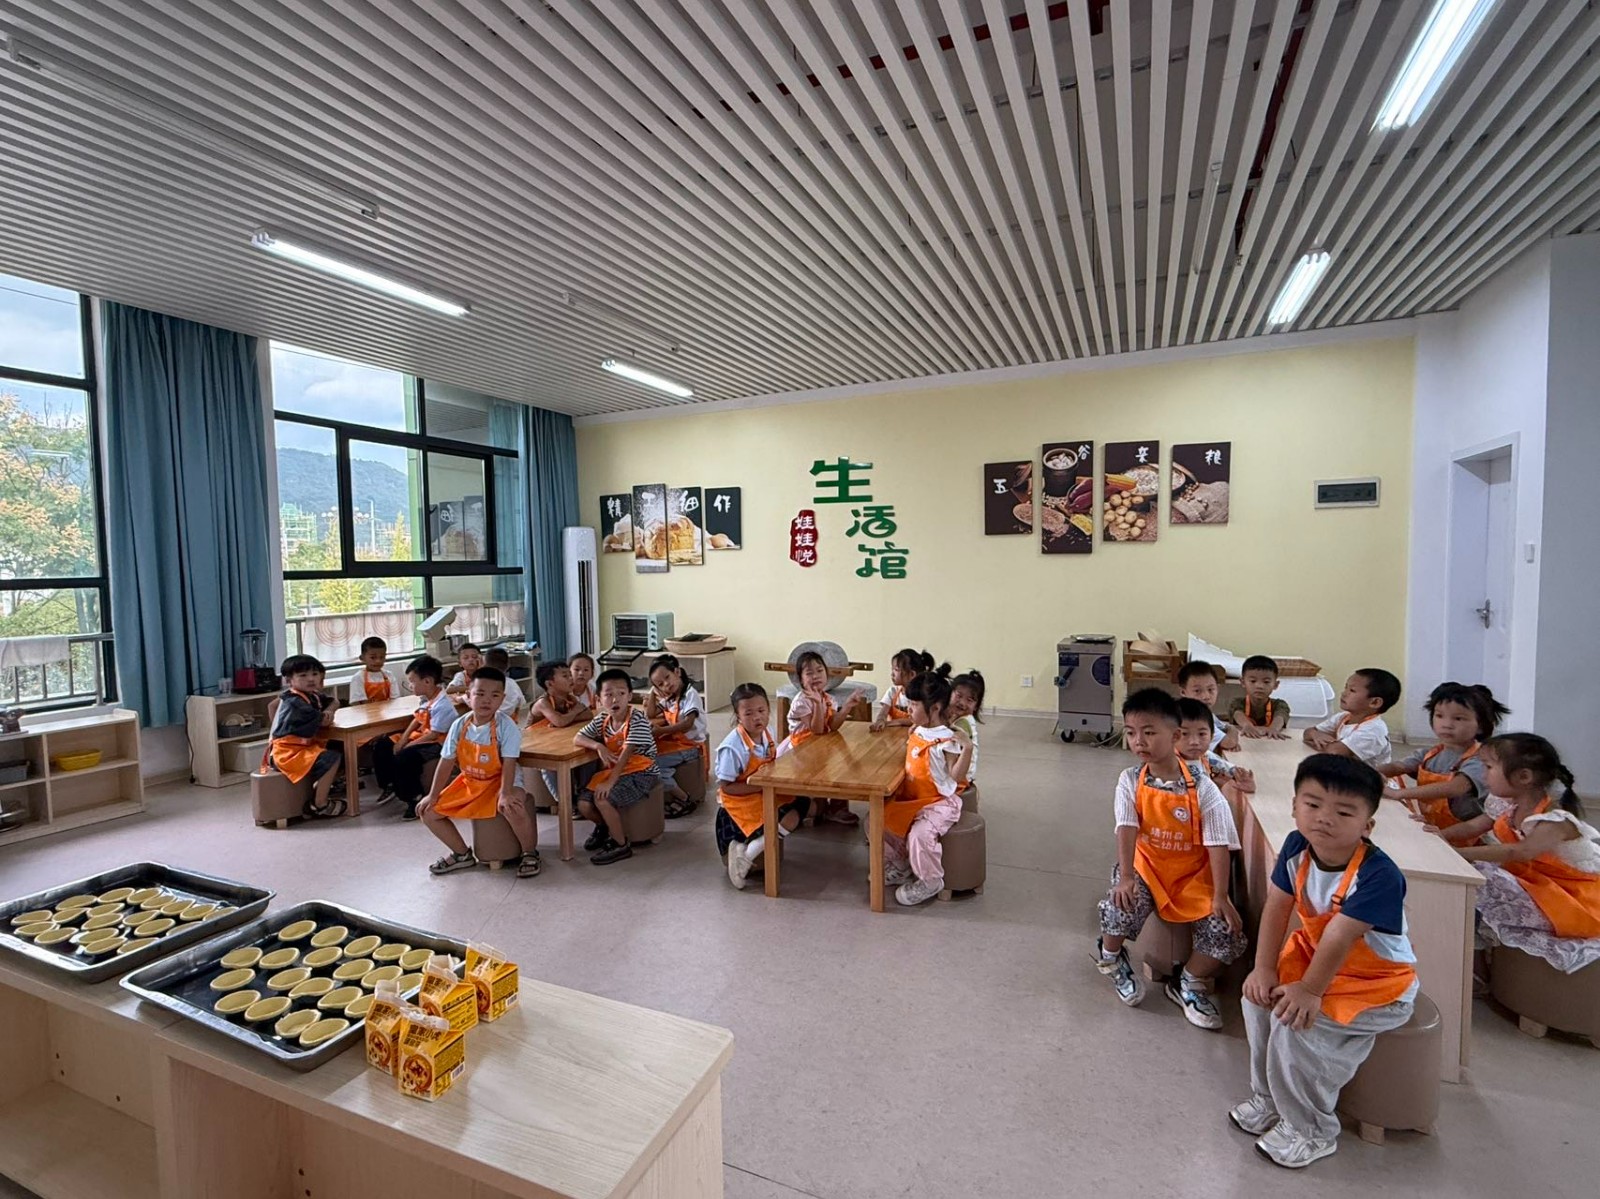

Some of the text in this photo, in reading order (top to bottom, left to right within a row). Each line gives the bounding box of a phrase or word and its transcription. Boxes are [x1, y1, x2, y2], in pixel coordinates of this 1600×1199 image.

[606, 490, 732, 519] 精工细作
[809, 456, 909, 579] 生活馆
[794, 515, 816, 564] 娃娃悦
